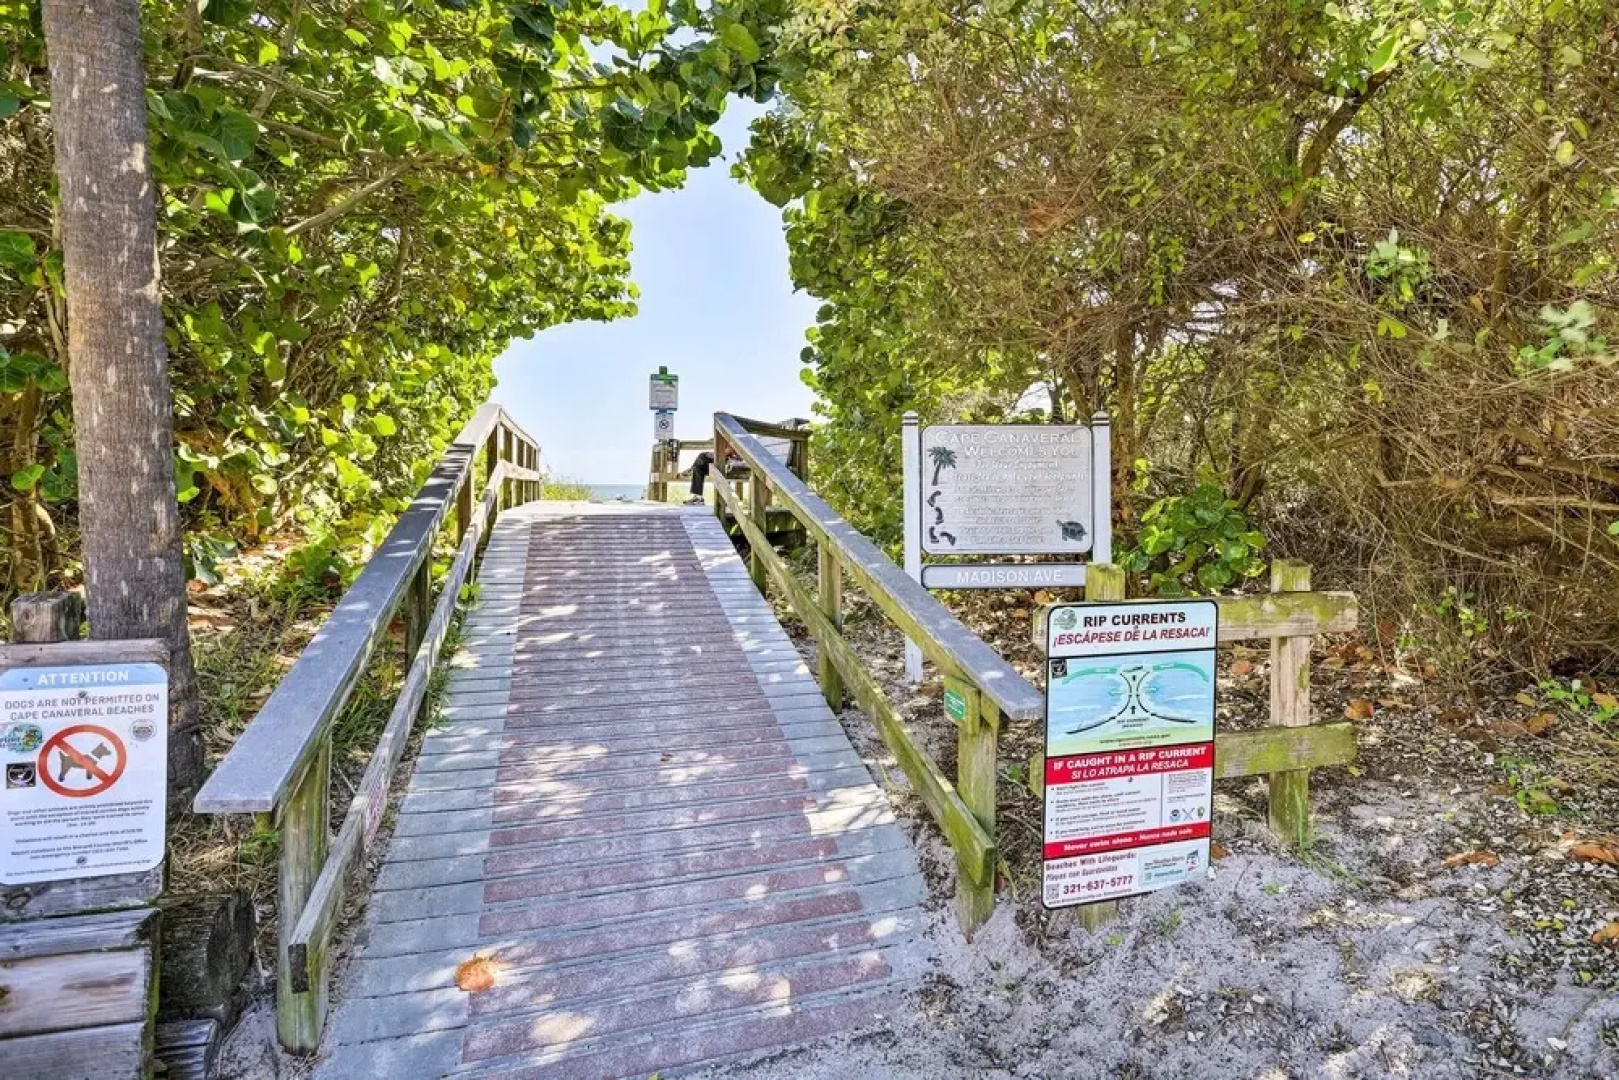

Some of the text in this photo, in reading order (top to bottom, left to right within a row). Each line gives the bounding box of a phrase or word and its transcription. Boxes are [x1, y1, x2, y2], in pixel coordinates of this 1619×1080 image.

[935, 431, 1077, 445] CAPE CANAVERAL
[957, 569, 1062, 584] MADISON AVE
[1083, 612, 1186, 627] RIP CURRENTS
[1053, 627, 1209, 647] ¡ESCÁPESE DE LA RESACA!
[38, 671, 129, 686] ATTENTION
[5, 693, 160, 710] DOGS ARE NOT PERMITTED ON
[10, 705, 155, 721] CAPE CANAVERAL BEACHES
[1053, 747, 1206, 771] IF CAUGHT IN A RIP CURRENT
[1071, 759, 1189, 780] SI LO ATRAPA LA RESACA
[1046, 861, 1077, 871] Beaches
[1079, 857, 1097, 865] With
[1063, 876, 1133, 894] 321-637-5777
